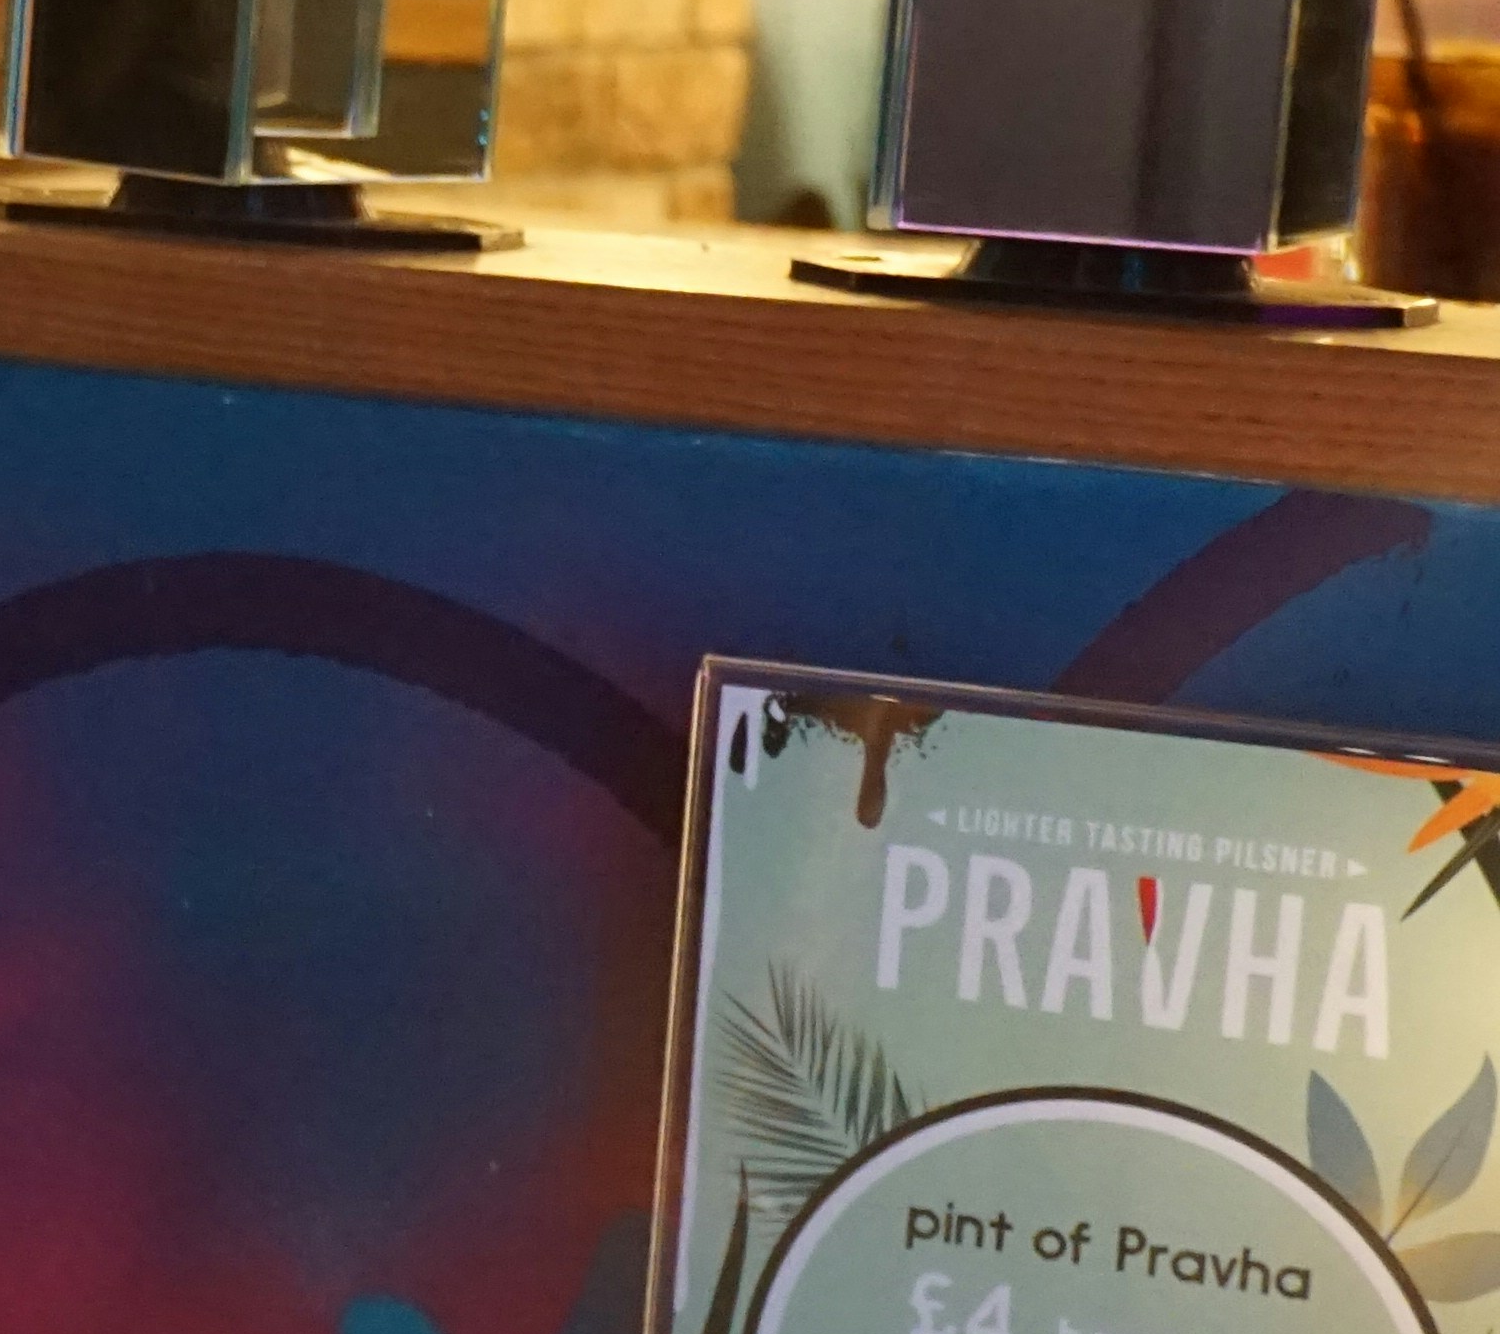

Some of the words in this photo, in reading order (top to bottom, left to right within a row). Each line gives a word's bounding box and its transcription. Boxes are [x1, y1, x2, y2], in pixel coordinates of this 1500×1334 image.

[957, 807, 1072, 845] LIGHTER
[1087, 821, 1201, 862] TASTING
[1214, 837, 1337, 878] PILSNER
[876, 843, 1390, 1060] PRAVHA
[904, 1202, 1013, 1252] pint
[1032, 1221, 1092, 1265] of
[1116, 1225, 1313, 1301] Pravha
